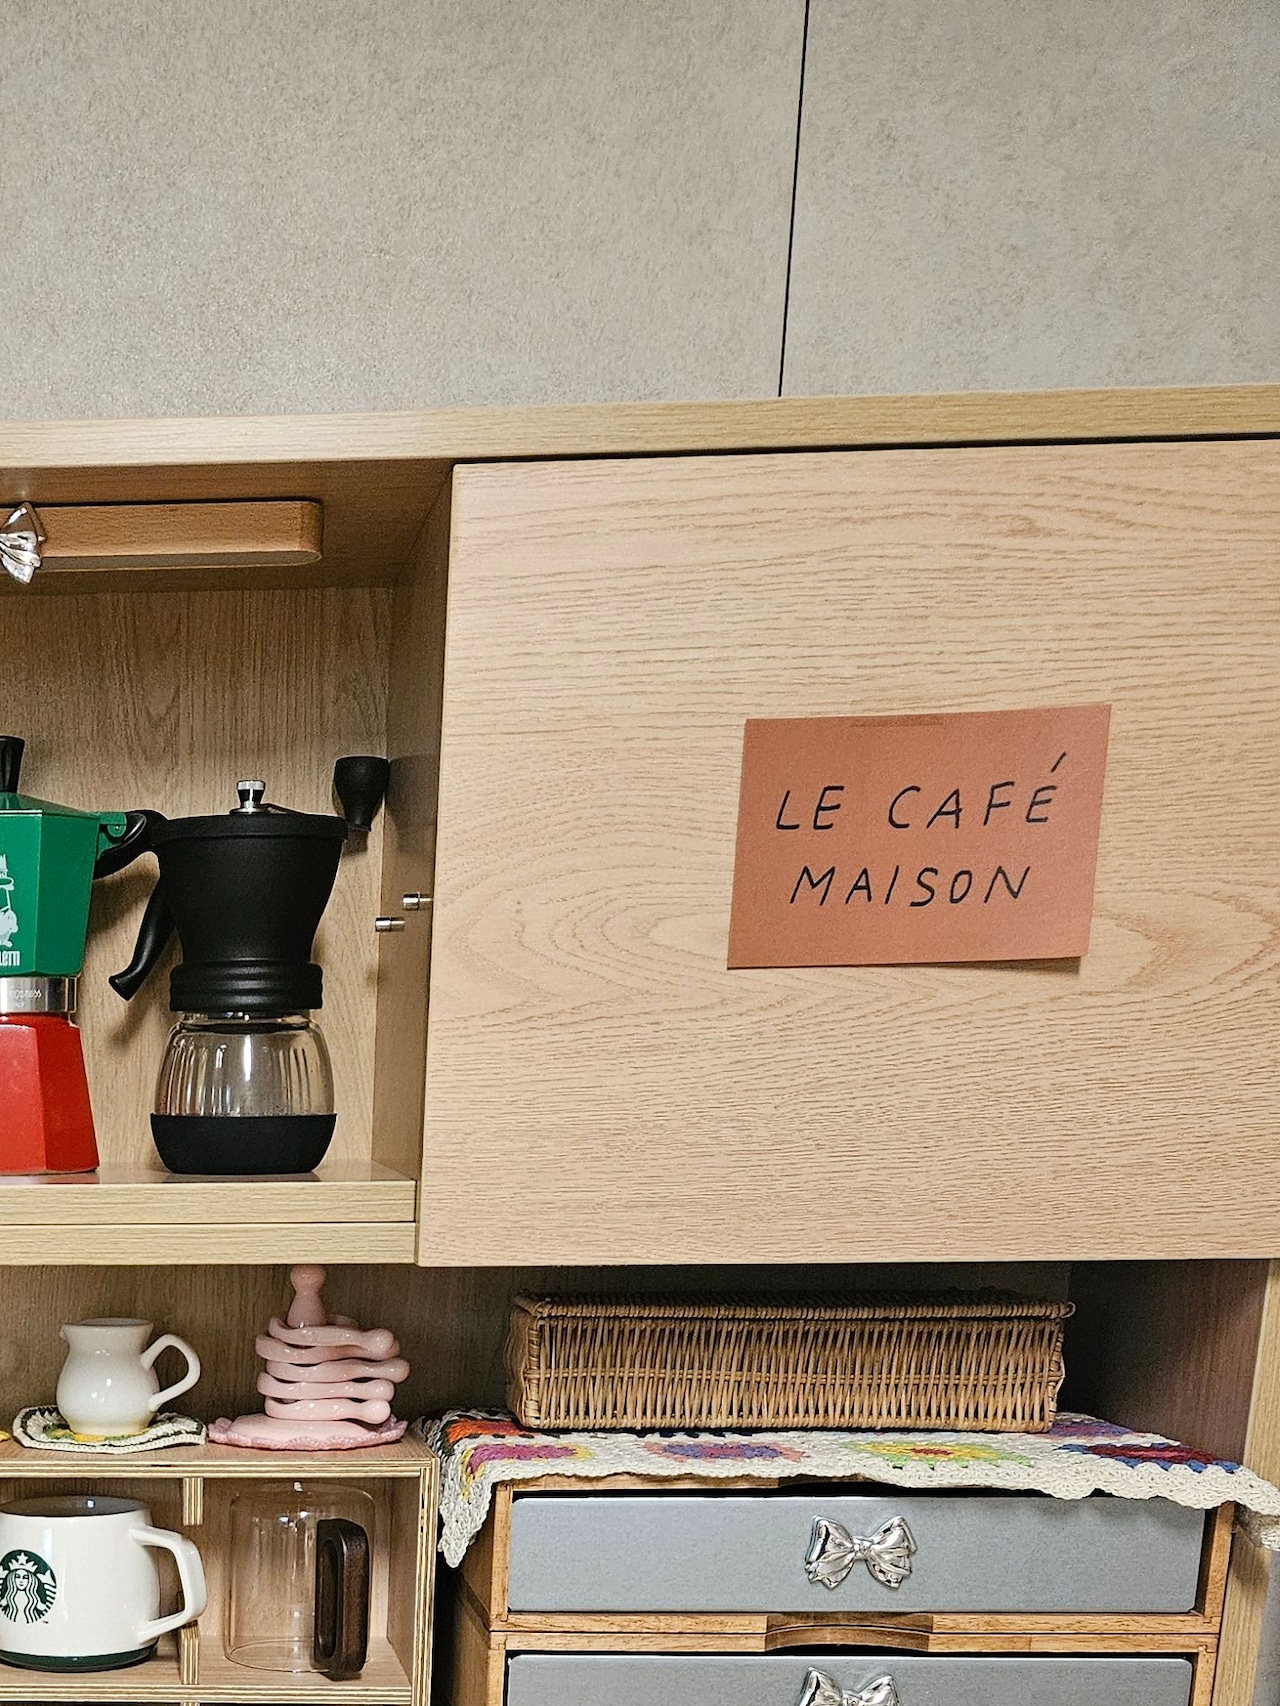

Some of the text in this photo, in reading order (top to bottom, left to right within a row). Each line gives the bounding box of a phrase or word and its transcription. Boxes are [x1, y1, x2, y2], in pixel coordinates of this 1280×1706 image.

[776, 752, 1067, 830] LE CAFÉ
[789, 865, 1030, 907] MAISON
